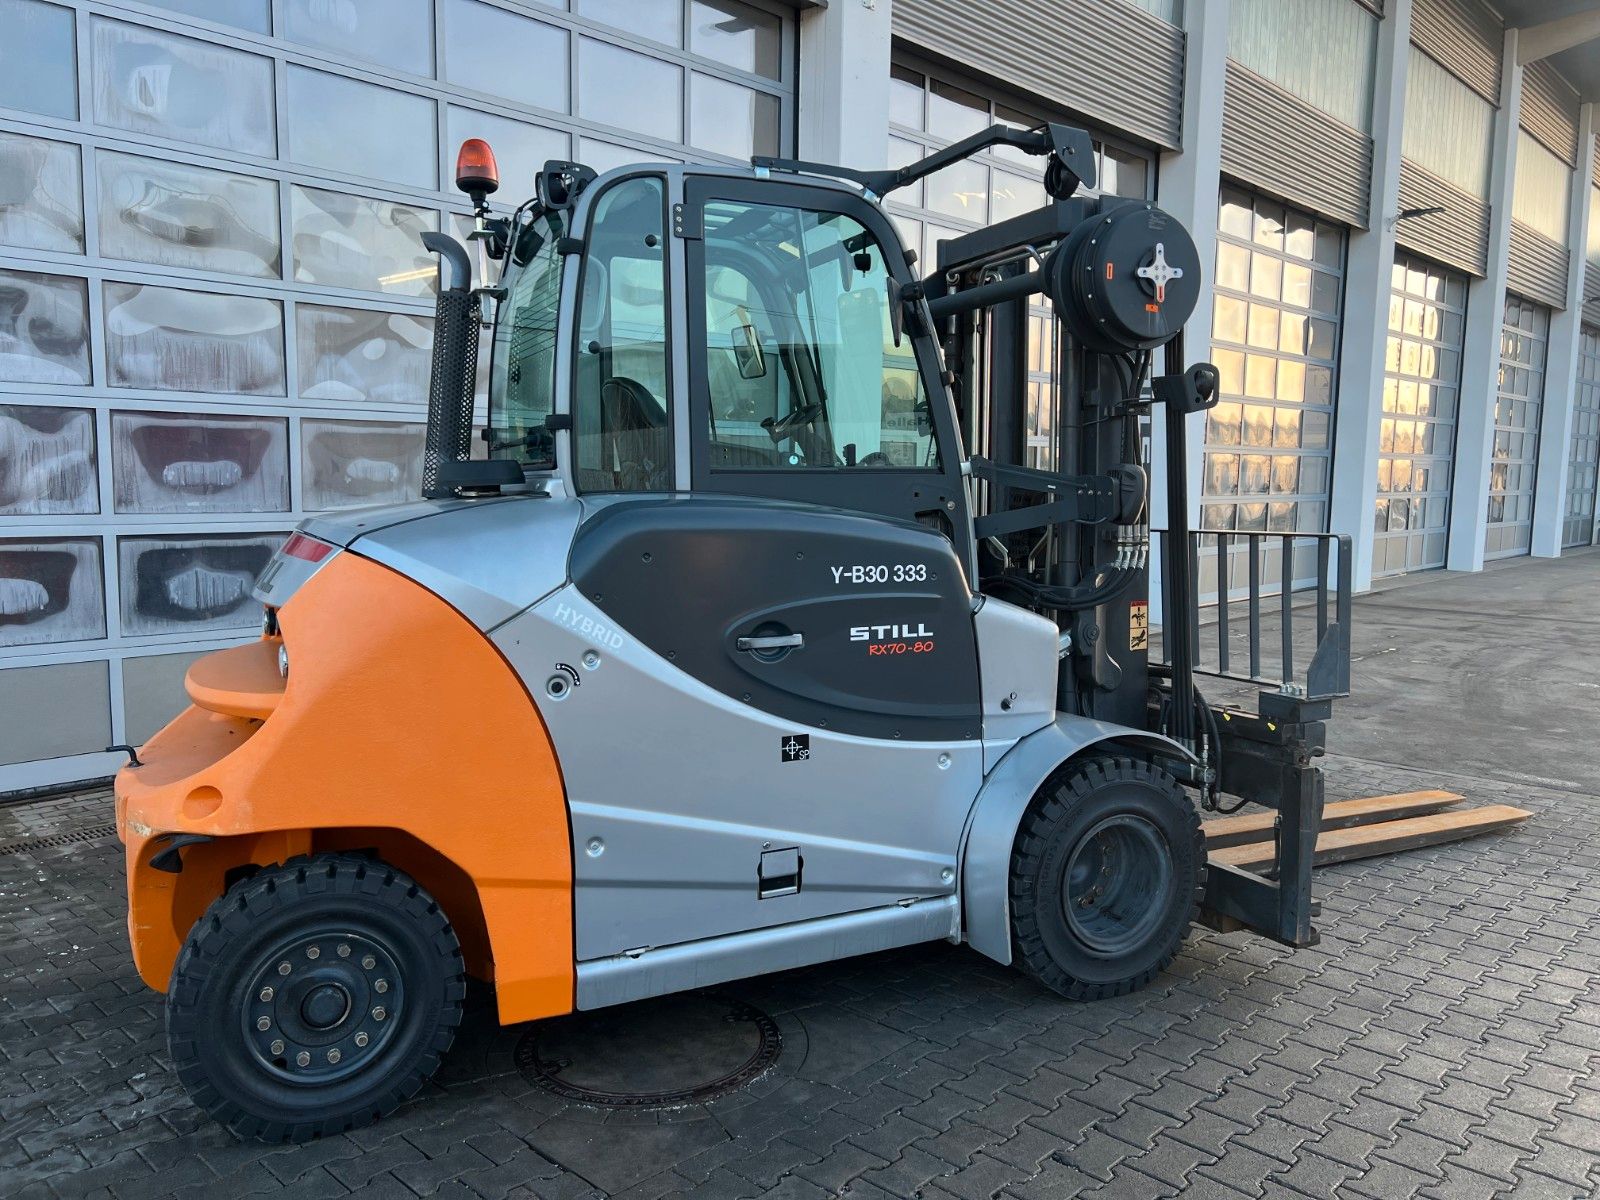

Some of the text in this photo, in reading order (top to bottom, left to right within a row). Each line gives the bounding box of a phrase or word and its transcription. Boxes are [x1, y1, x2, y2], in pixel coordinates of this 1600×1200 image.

[830, 564, 927, 584] Y-B30 333
[555, 603, 624, 649] HYBRID
[850, 623, 934, 641] STILL
[869, 641, 934, 655] RX70-80
[799, 749, 810, 760] SP
